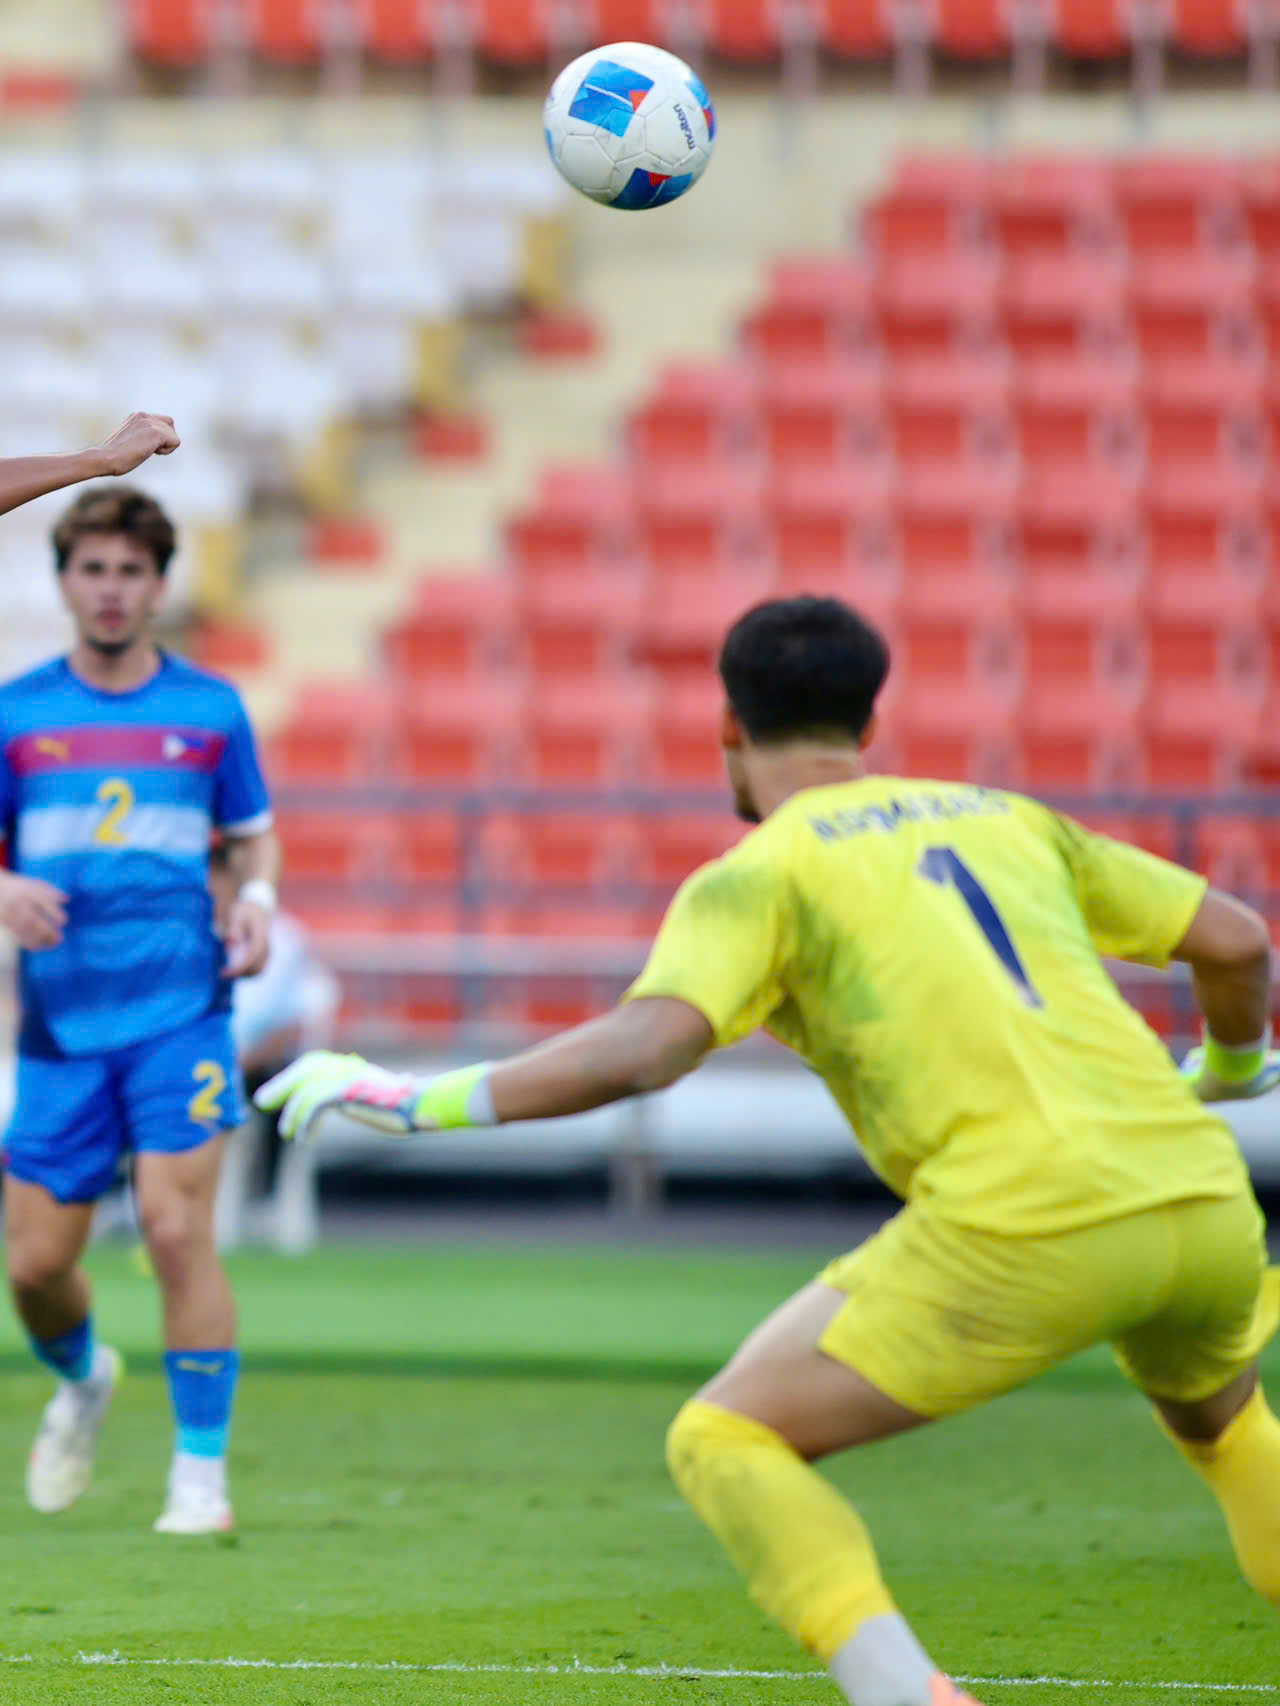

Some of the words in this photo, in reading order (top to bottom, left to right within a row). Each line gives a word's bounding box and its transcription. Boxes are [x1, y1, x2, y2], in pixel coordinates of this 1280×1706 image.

[674, 103, 696, 150] molten
[94, 776, 134, 848] 2
[918, 845, 1045, 1010] 1
[189, 1060, 226, 1123] 2
